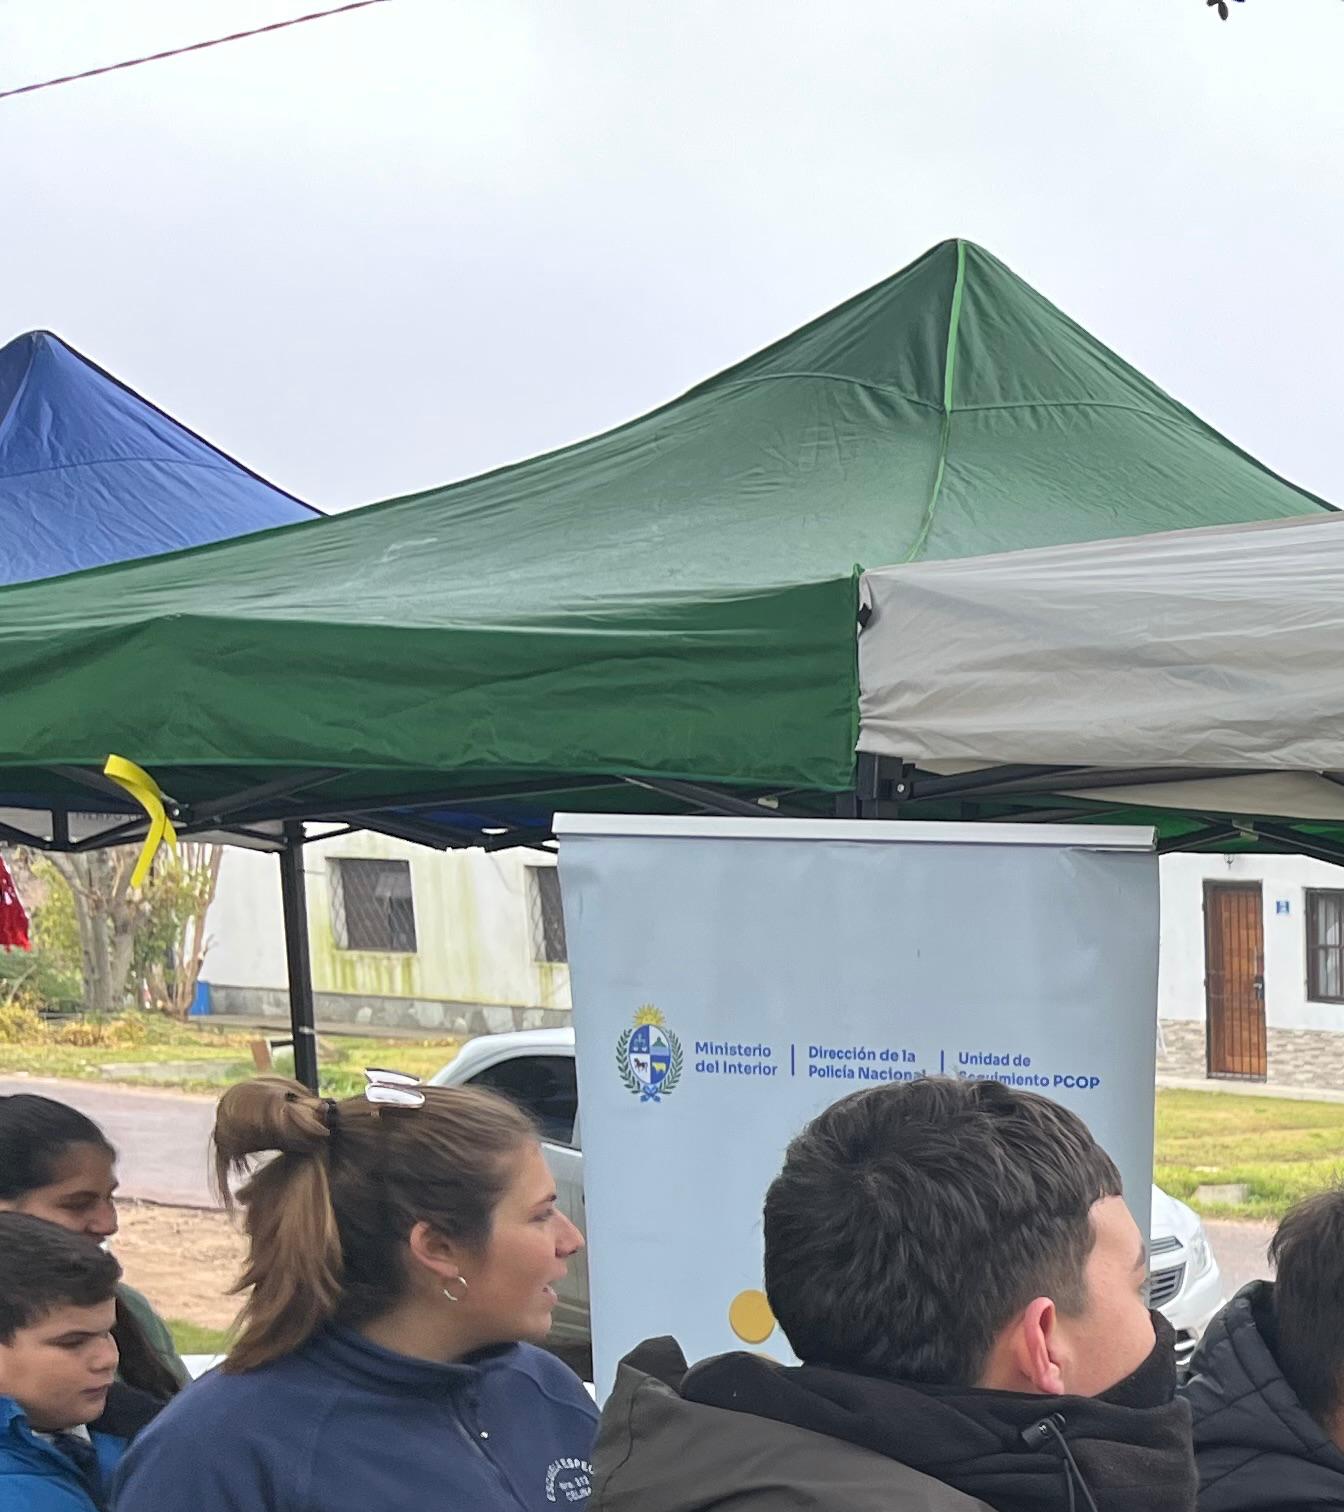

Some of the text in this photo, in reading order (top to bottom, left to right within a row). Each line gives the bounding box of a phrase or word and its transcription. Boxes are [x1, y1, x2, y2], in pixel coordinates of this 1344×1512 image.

[695, 1041, 771, 1057] Ministerio
[808, 1045, 916, 1063] Dirección de la
[695, 1059, 778, 1076] del Interior
[958, 1052, 1031, 1067] Unidad de
[808, 1064, 855, 1079] Policía
[1053, 1074, 1101, 1090] PCOP
